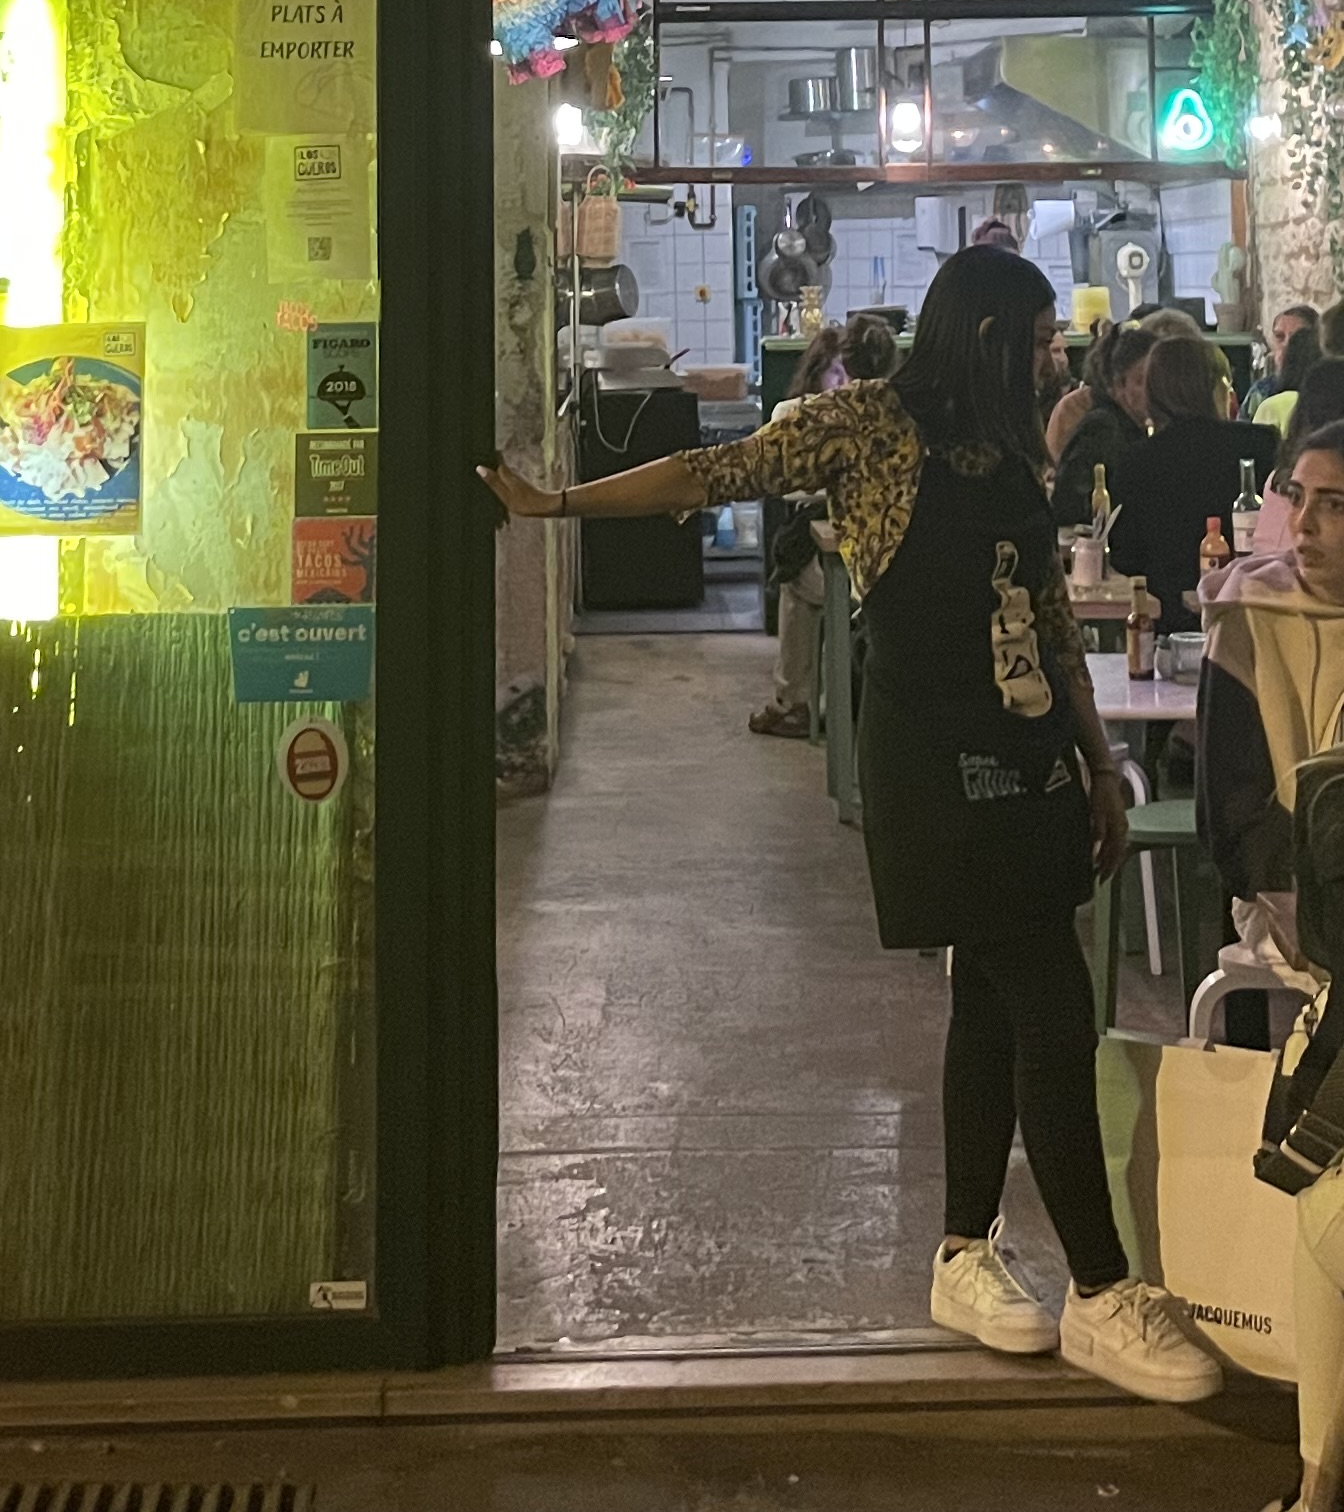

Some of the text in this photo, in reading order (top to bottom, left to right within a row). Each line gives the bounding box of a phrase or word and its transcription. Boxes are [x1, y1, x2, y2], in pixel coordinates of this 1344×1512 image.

[271, 0, 343, 24] PLATS À
[260, 41, 354, 60] EMPORTER
[299, 150, 319, 160] LOS
[312, 338, 371, 349] FIGARO
[325, 381, 357, 393] 2018
[297, 553, 342, 569] TACOS
[238, 622, 368, 643] c'est ouvert
[1189, 1302, 1273, 1335] JACQUEMUS
